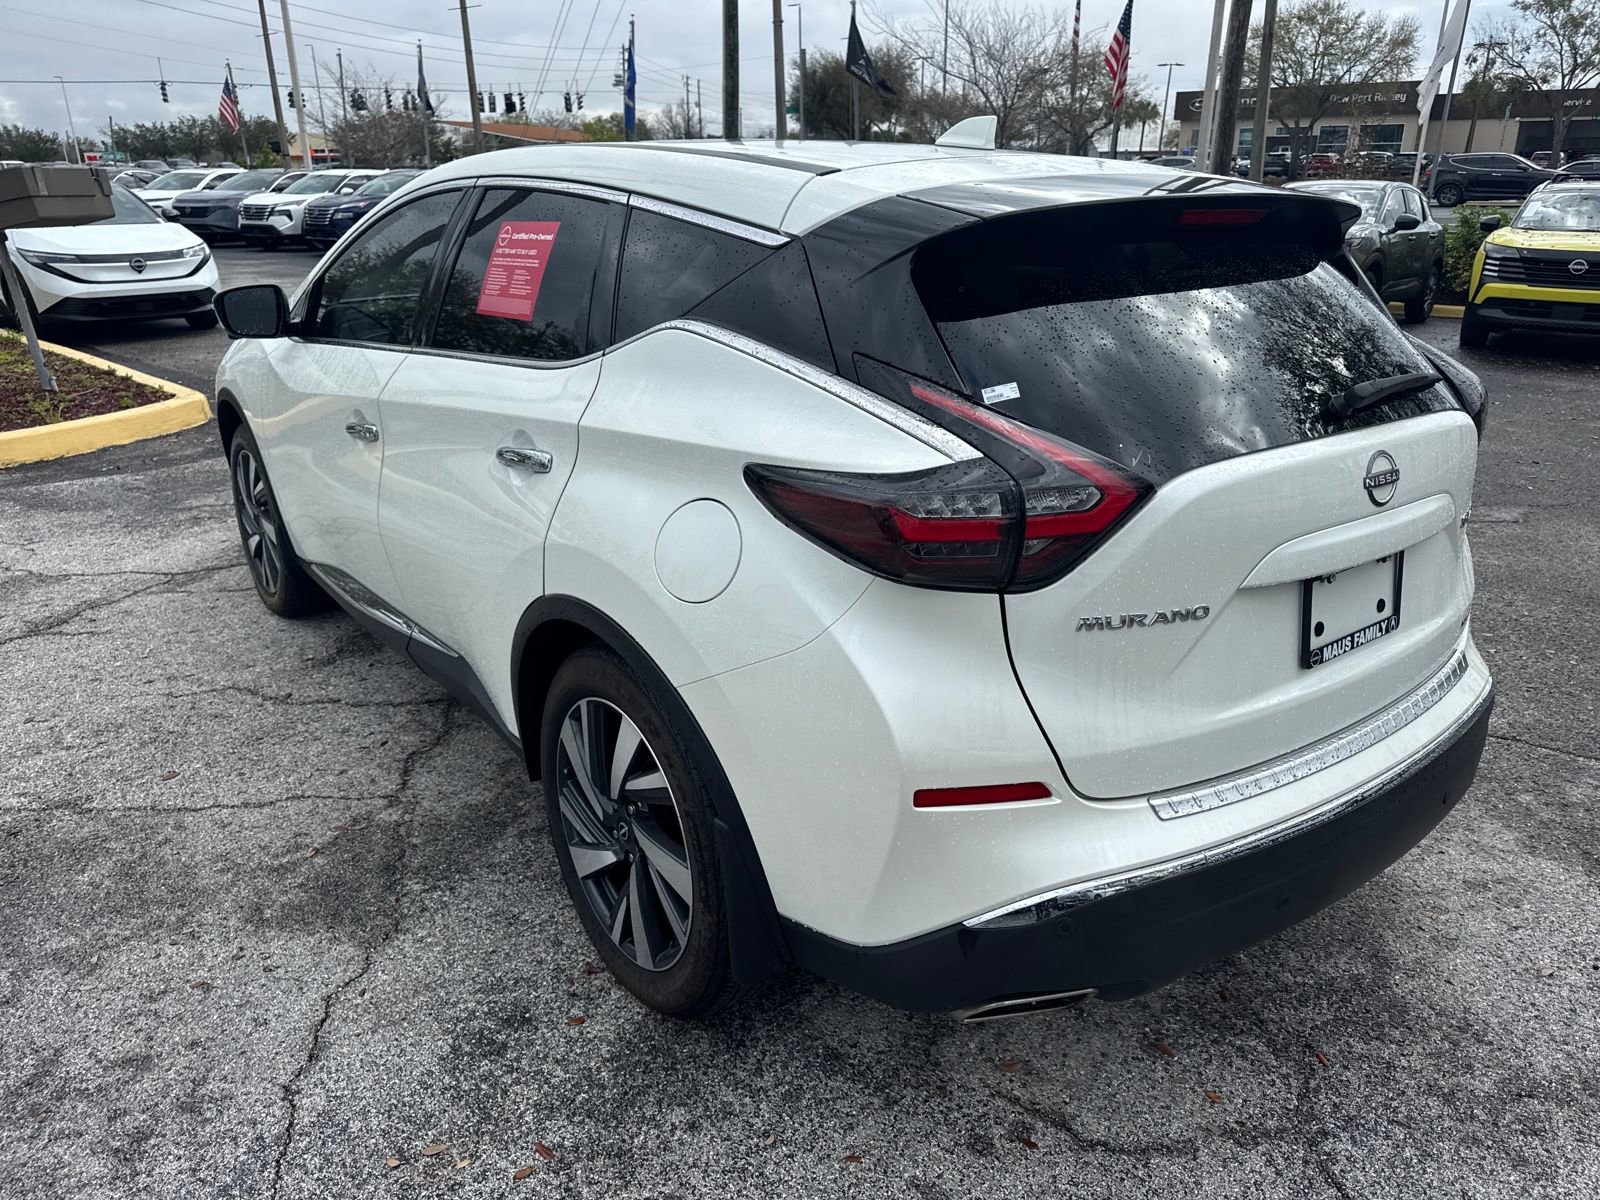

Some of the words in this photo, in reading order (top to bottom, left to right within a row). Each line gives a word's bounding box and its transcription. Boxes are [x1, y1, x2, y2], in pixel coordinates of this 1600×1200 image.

[511, 232, 530, 240] Certified
[529, 232, 554, 241] Pre-Owned
[1365, 470, 1400, 488] NISSAN
[1075, 603, 1211, 632] MURANO
[1322, 636, 1352, 662] MAUS
[1354, 619, 1388, 648] FAMILY
